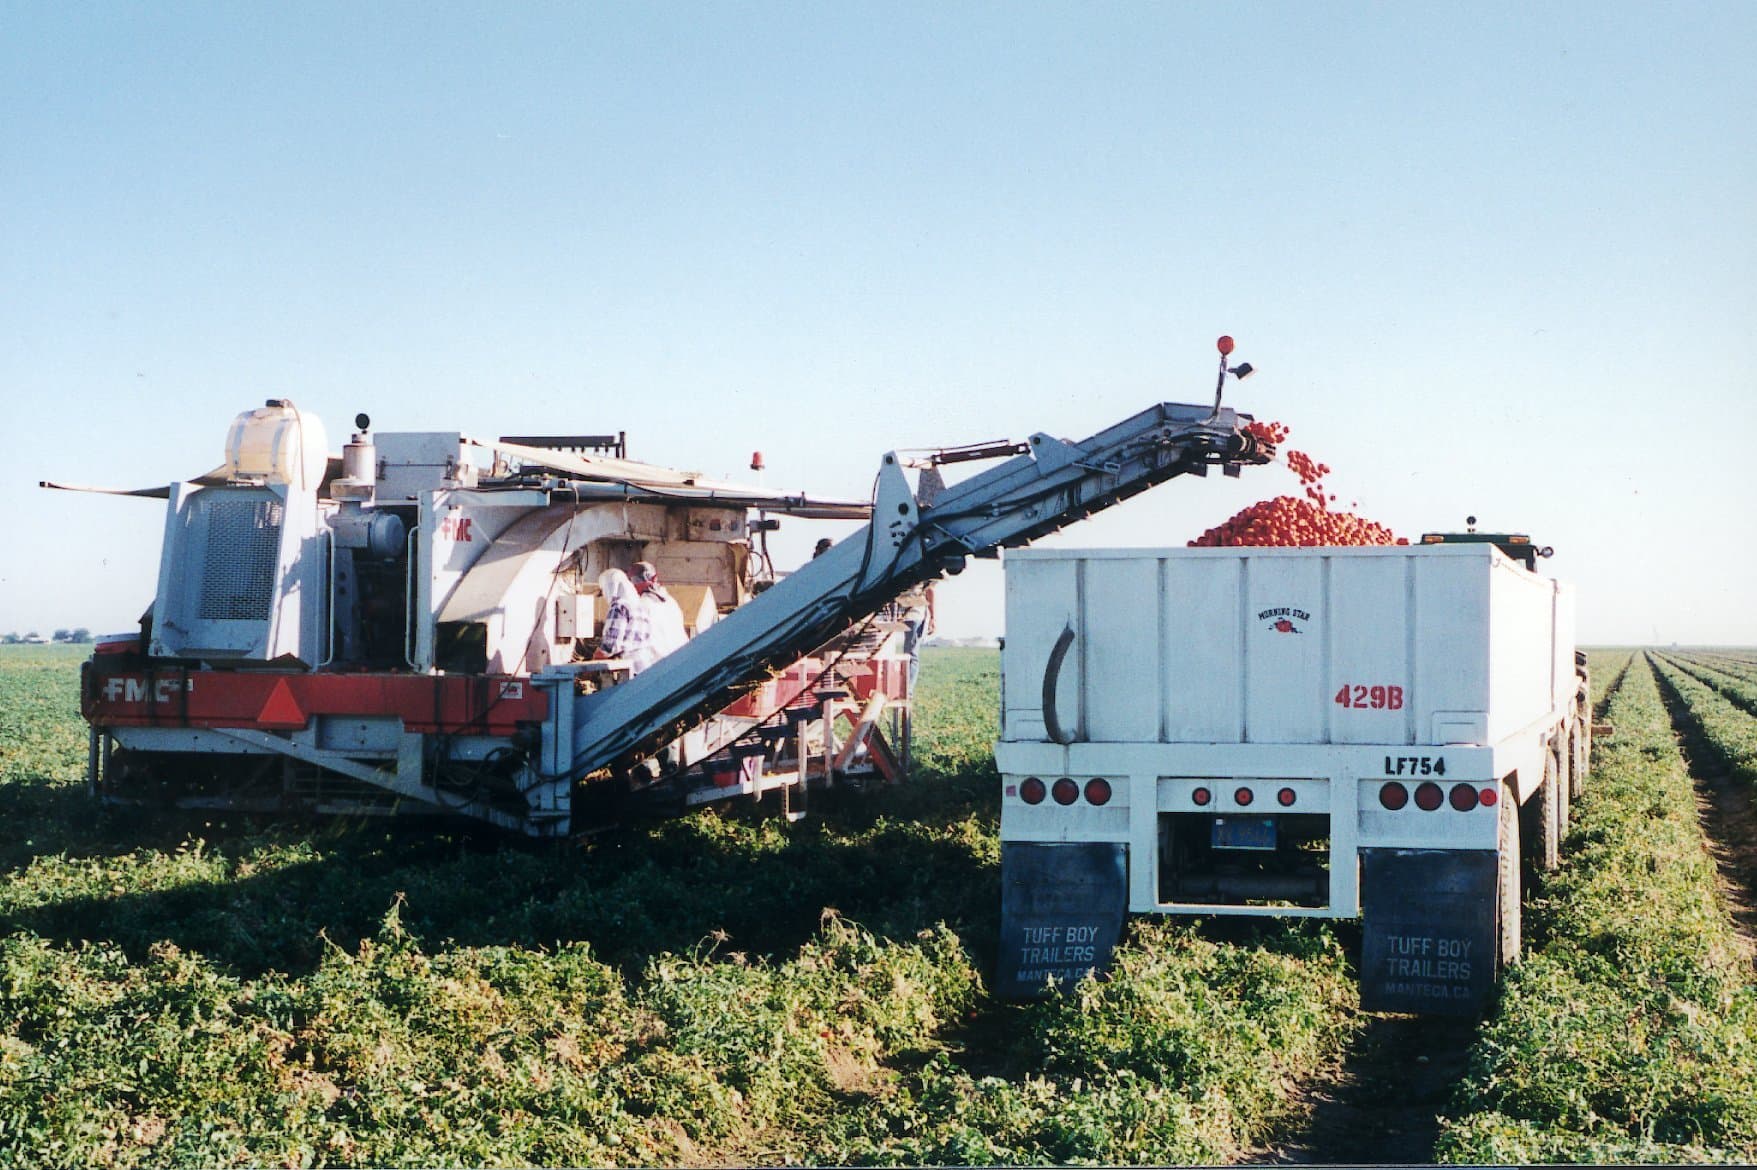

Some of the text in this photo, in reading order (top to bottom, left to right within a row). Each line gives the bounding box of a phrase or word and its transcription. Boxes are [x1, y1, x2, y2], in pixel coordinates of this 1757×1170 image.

[1258, 607, 1310, 621] MORNING STAR
[103, 678, 169, 702] FMC
[1335, 684, 1404, 710] 429B
[1385, 756, 1446, 776] LF754
[1023, 926, 1098, 944] TUFF BOY
[1021, 946, 1095, 963] TRAILERS
[1387, 936, 1472, 960] TUFF BOY
[1386, 958, 1471, 980] TRAILERS
